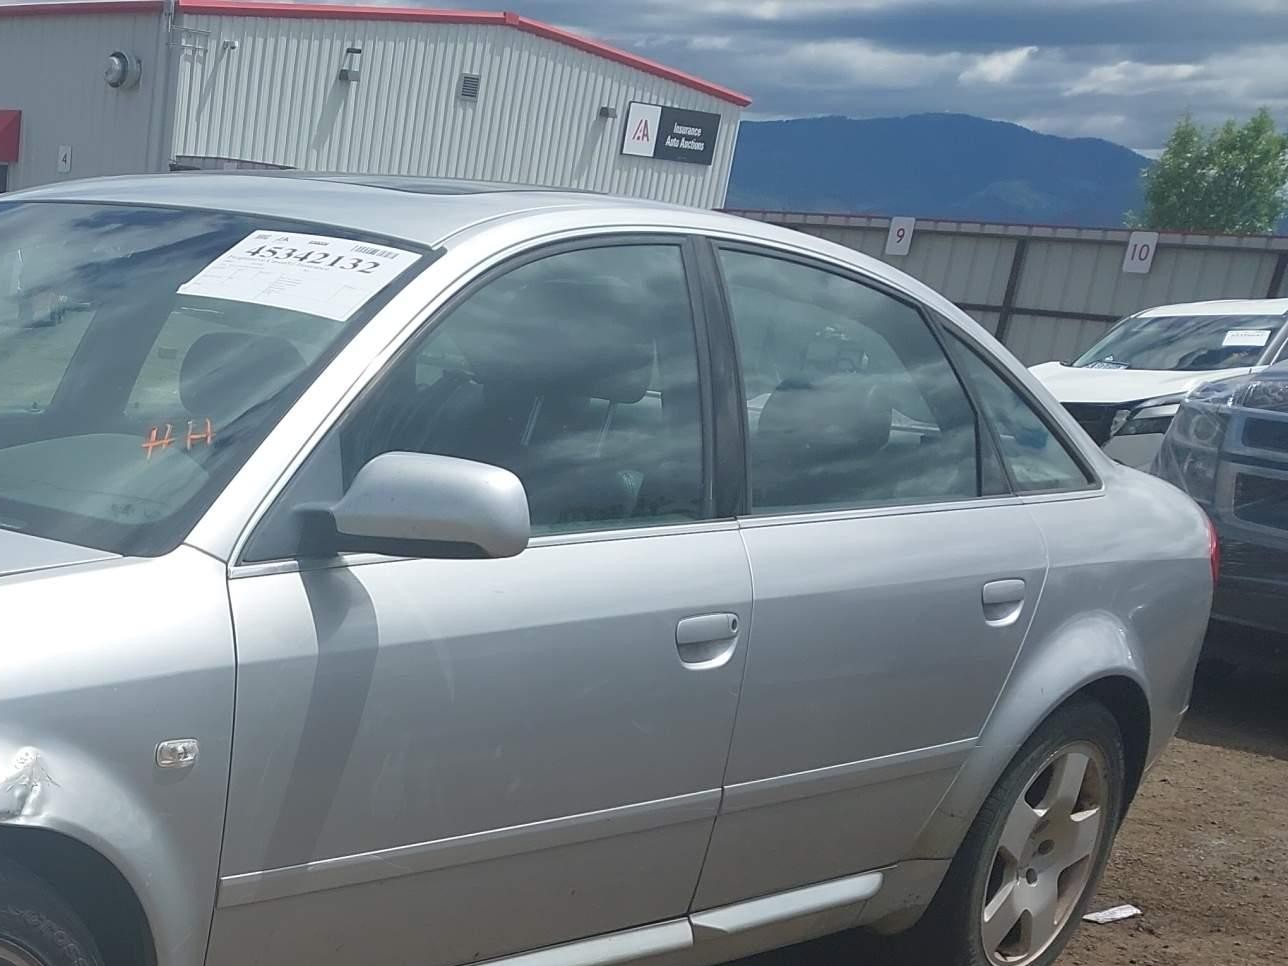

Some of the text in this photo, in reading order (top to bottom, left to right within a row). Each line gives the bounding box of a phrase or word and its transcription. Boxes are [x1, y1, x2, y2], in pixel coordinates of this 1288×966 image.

[673, 122, 702, 137] Insurance
[664, 135, 705, 151] Auto Auctions
[896, 228, 905, 243] 9
[245, 245, 381, 274] 45342132
[1130, 244, 1151, 261] 10
